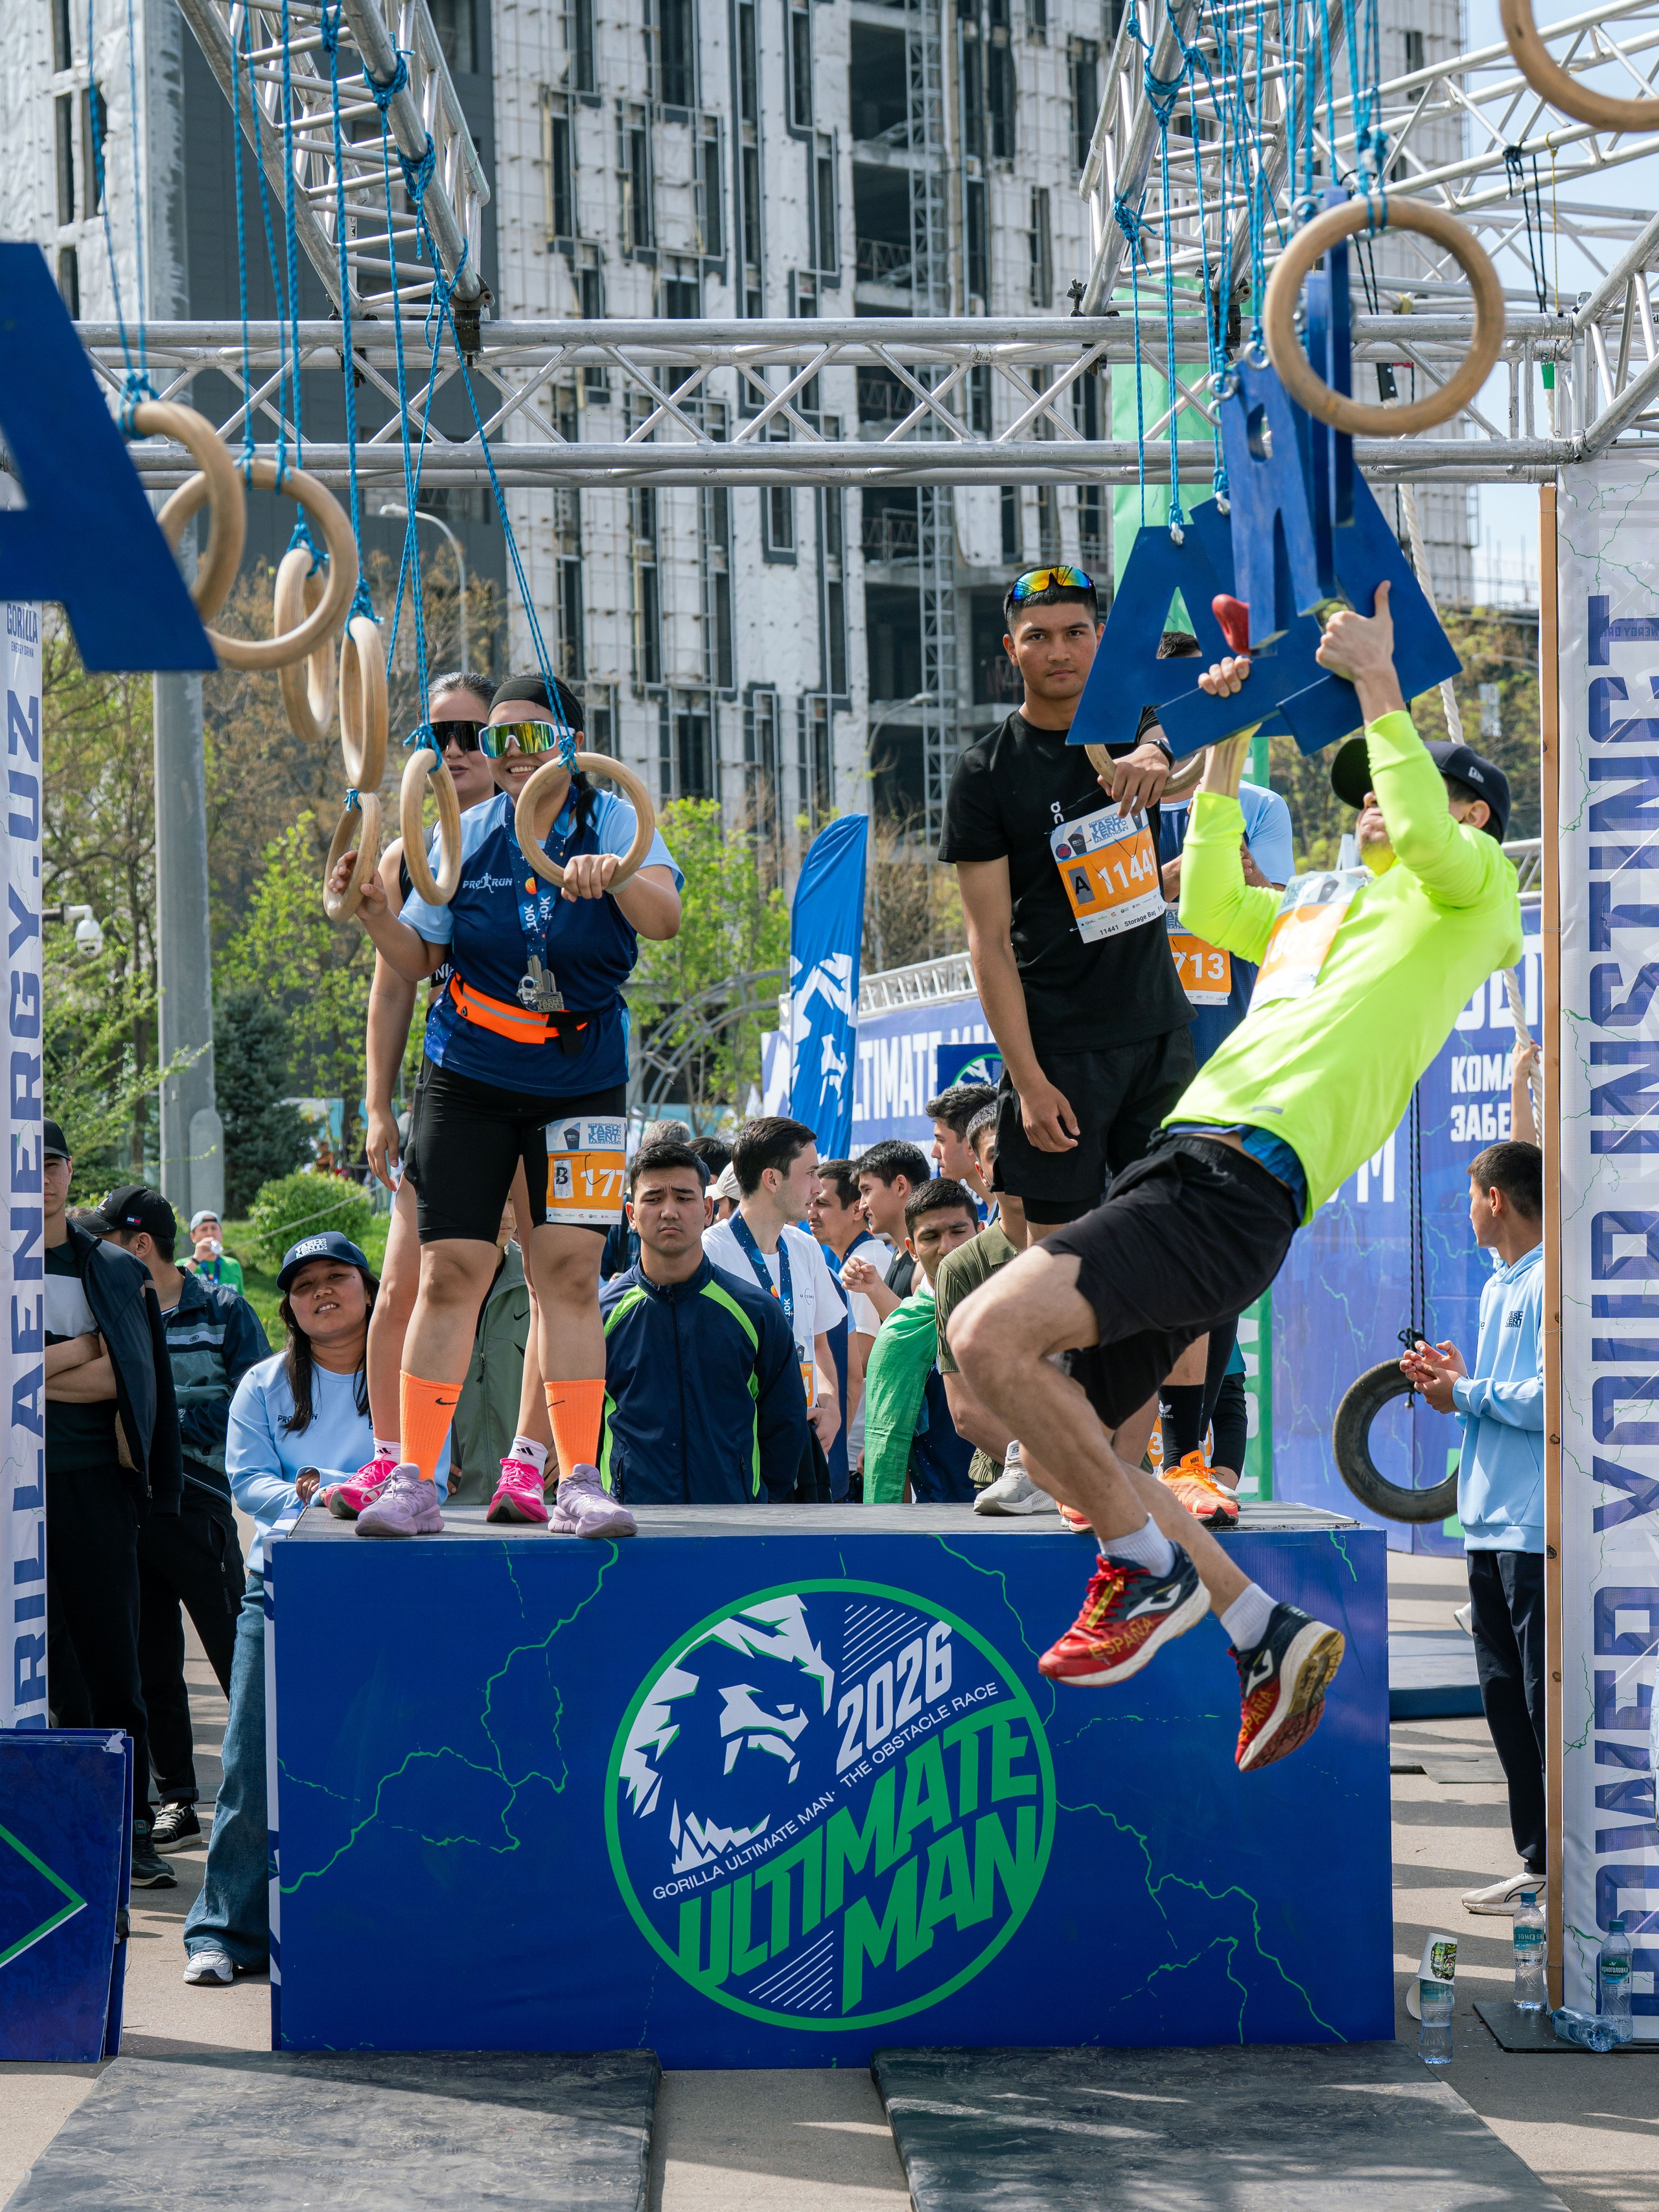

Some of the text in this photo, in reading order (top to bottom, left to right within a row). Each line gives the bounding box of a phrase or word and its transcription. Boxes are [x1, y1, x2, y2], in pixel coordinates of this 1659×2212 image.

[7, 603, 38, 644] GORILLA
[1089, 816, 1122, 833] TASH
[1091, 822, 1122, 841] KENT
[1098, 846, 1157, 894] 11441
[491, 878, 513, 887] RUN
[1075, 876, 1091, 894] A
[524, 903, 536, 929] 10K
[1124, 914, 1147, 927] Storage
[1147, 909, 1157, 918] Bag
[1099, 925, 1119, 935] 11441
[435, 963, 453, 981] NI
[1172, 951, 1225, 980] 713
[1450, 1053, 1514, 1094] КОМА
[587, 1125, 618, 1134] TASH
[1450, 1102, 1511, 1143] ЗАБЕ
[588, 1133, 618, 1142] KENT
[555, 1167, 568, 1185] B
[7, 688, 47, 1729] RILLAENERGY.UZ
[295, 1238, 322, 1253] TASH
[296, 1244, 322, 1259] KENT
[1190, 1456, 1200, 1464] NIKE
[1088, 1616, 1155, 1660] ESPAÑA
[836, 1620, 952, 1776] 2026
[653, 1865, 725, 1900] GORILLA
[725, 1820, 799, 1870] ULTIMATE
[840, 1760, 873, 1787] THE
[872, 1705, 951, 1764] OBSTACLE
[951, 1682, 999, 1711] RACE
[679, 1706, 1037, 1985] ULTIMATE
[842, 1806, 1036, 2016] MAN
